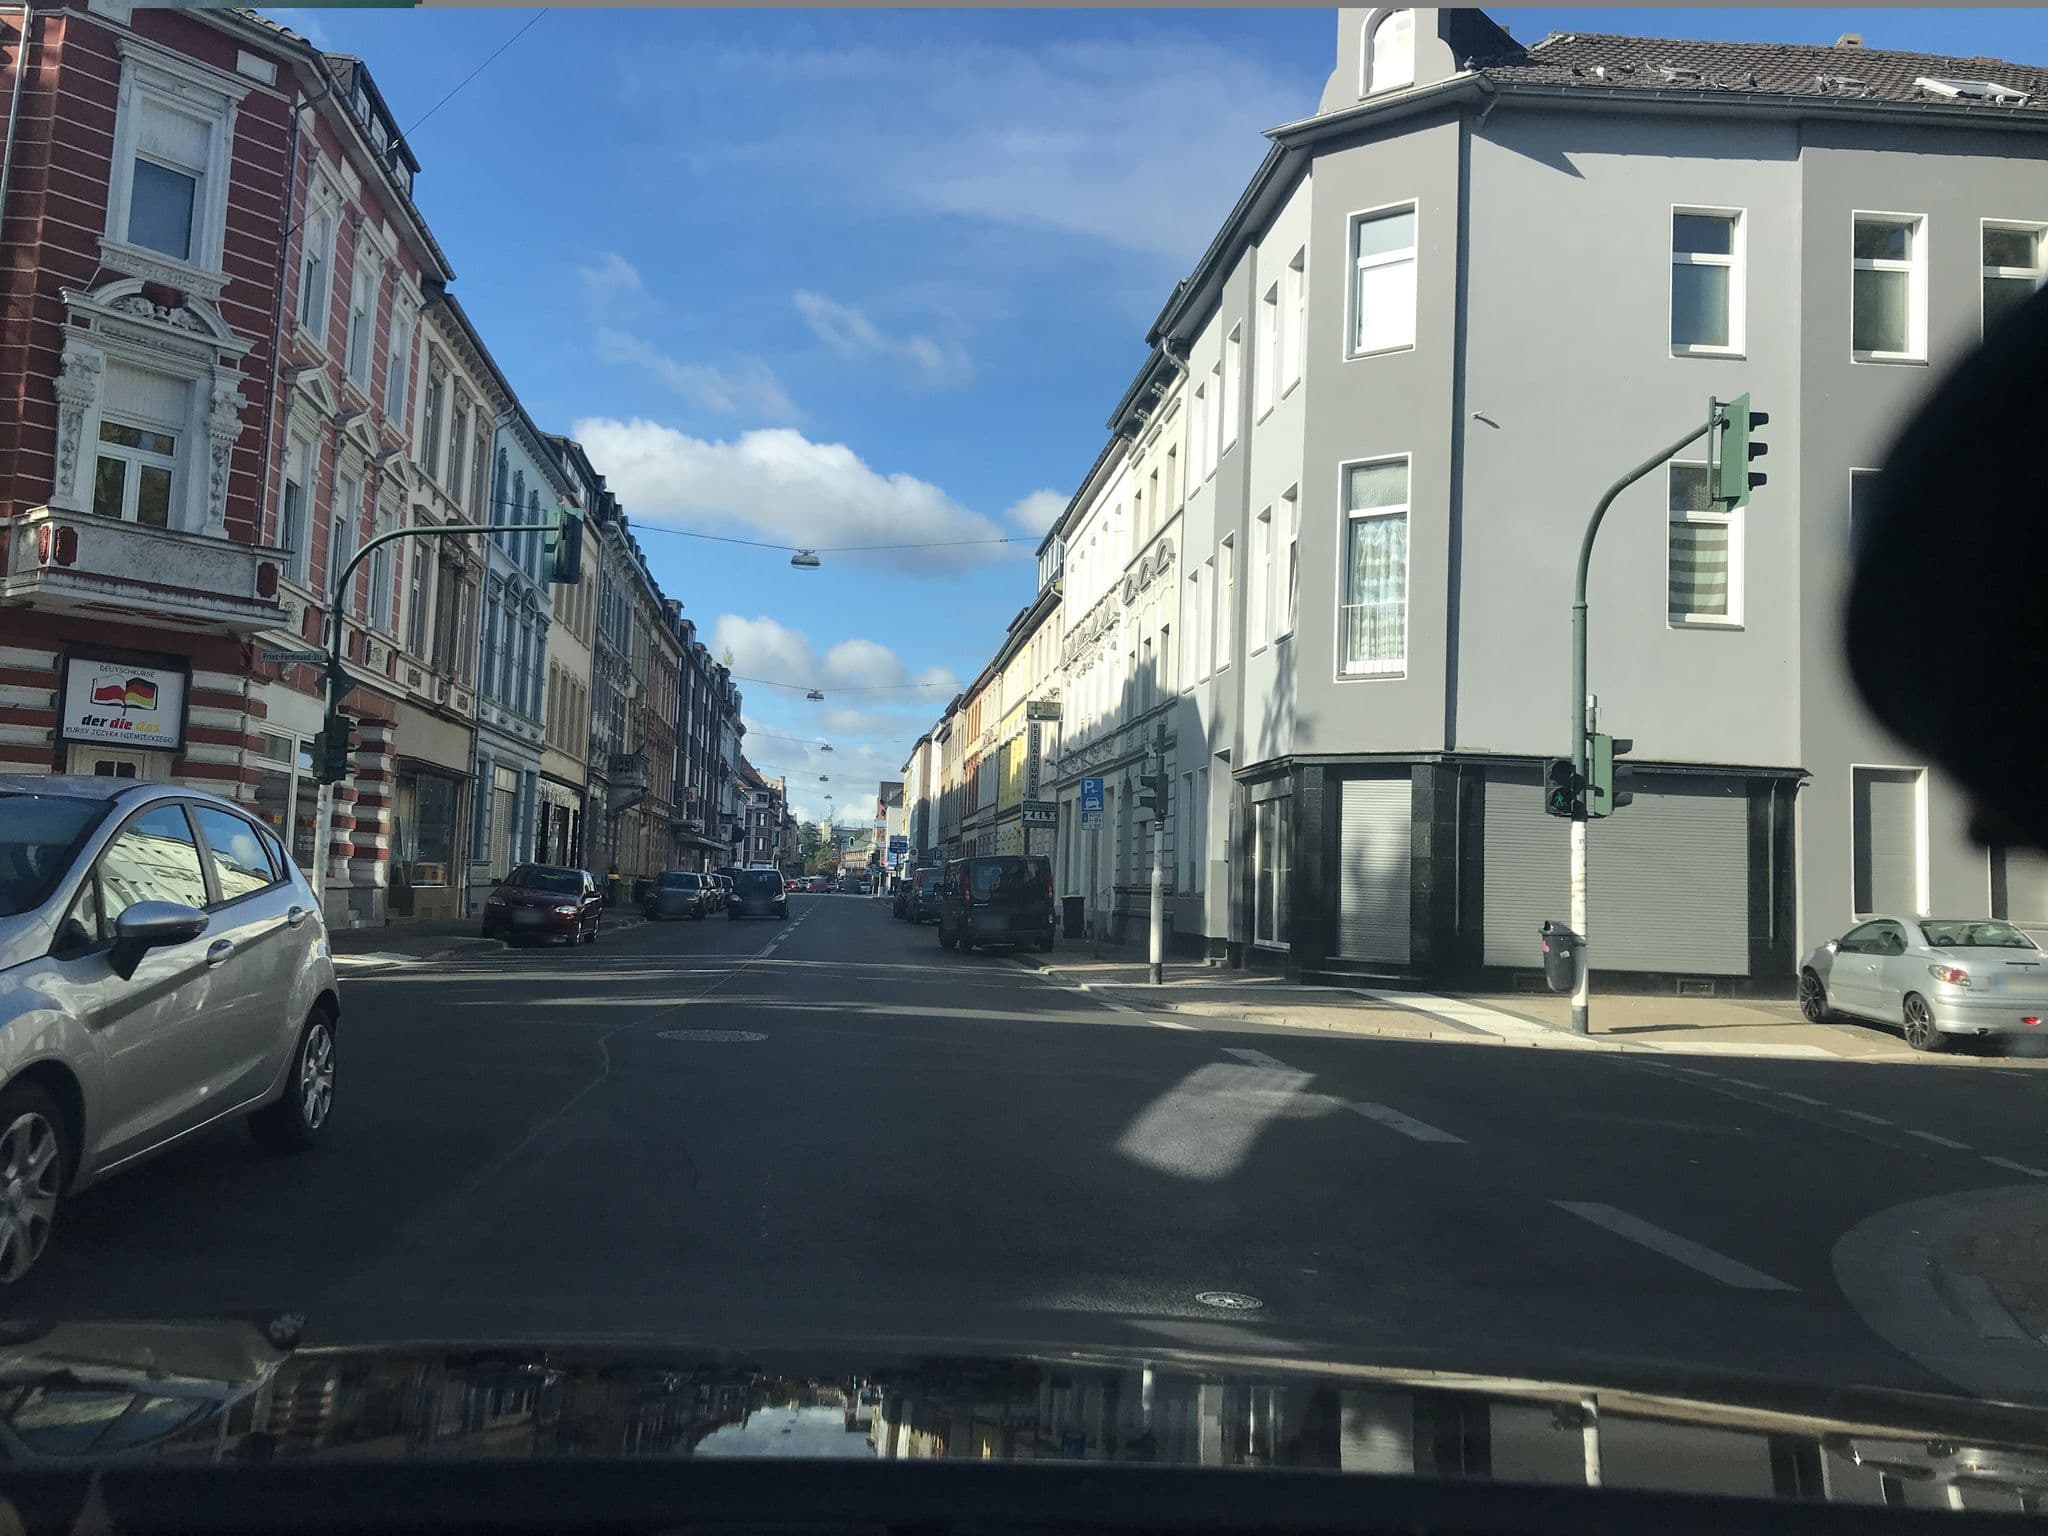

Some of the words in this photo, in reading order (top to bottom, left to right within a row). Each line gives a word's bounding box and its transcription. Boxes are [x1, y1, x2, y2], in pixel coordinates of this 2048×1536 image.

[99, 664, 156, 678] DEUTSCHKURSE
[81, 714, 108, 727] der
[109, 717, 133, 730] die
[135, 721, 160, 733] das
[65, 726, 90, 735] KURSY
[119, 731, 175, 743] NIEMIECKIEGO
[1084, 780, 1095, 794] P
[1023, 810, 1056, 821] ZELZ
